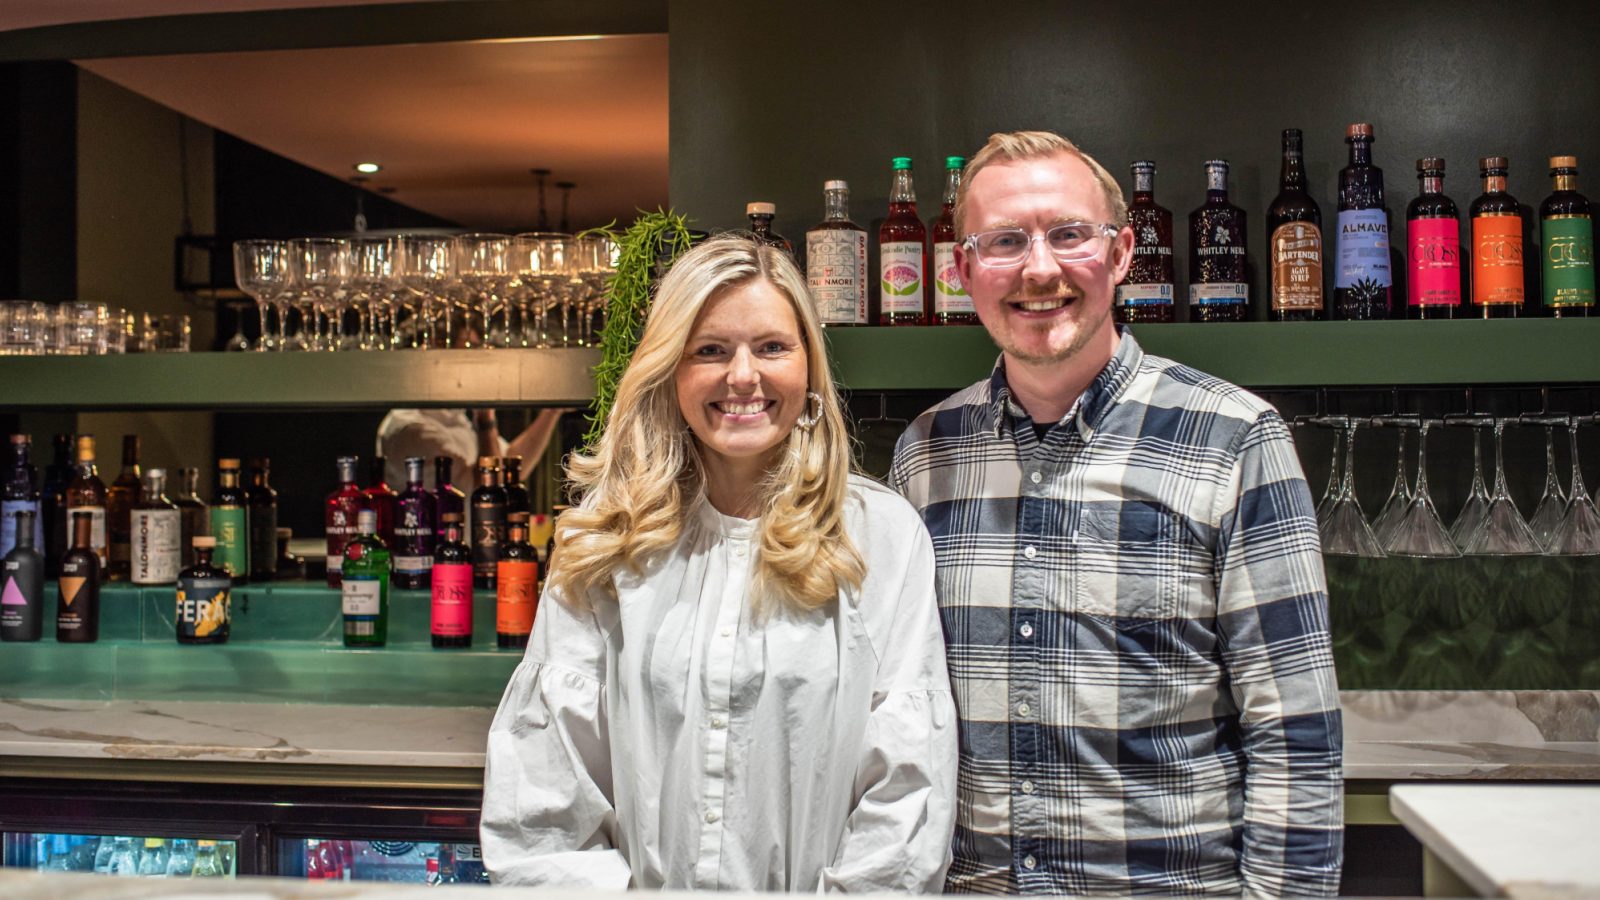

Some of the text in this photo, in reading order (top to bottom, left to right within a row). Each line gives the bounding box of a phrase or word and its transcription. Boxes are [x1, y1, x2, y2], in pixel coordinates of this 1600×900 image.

[1133, 246, 1172, 255] HITLEY NEILL
[1198, 247, 1245, 255] WHITLEY NEILL
[1278, 251, 1319, 263] BARTENDER
[859, 263, 865, 275] TO
[1291, 267, 1309, 275] AGAVE
[810, 278, 853, 286] TALNMORE
[1290, 274, 1310, 282] SYRUP
